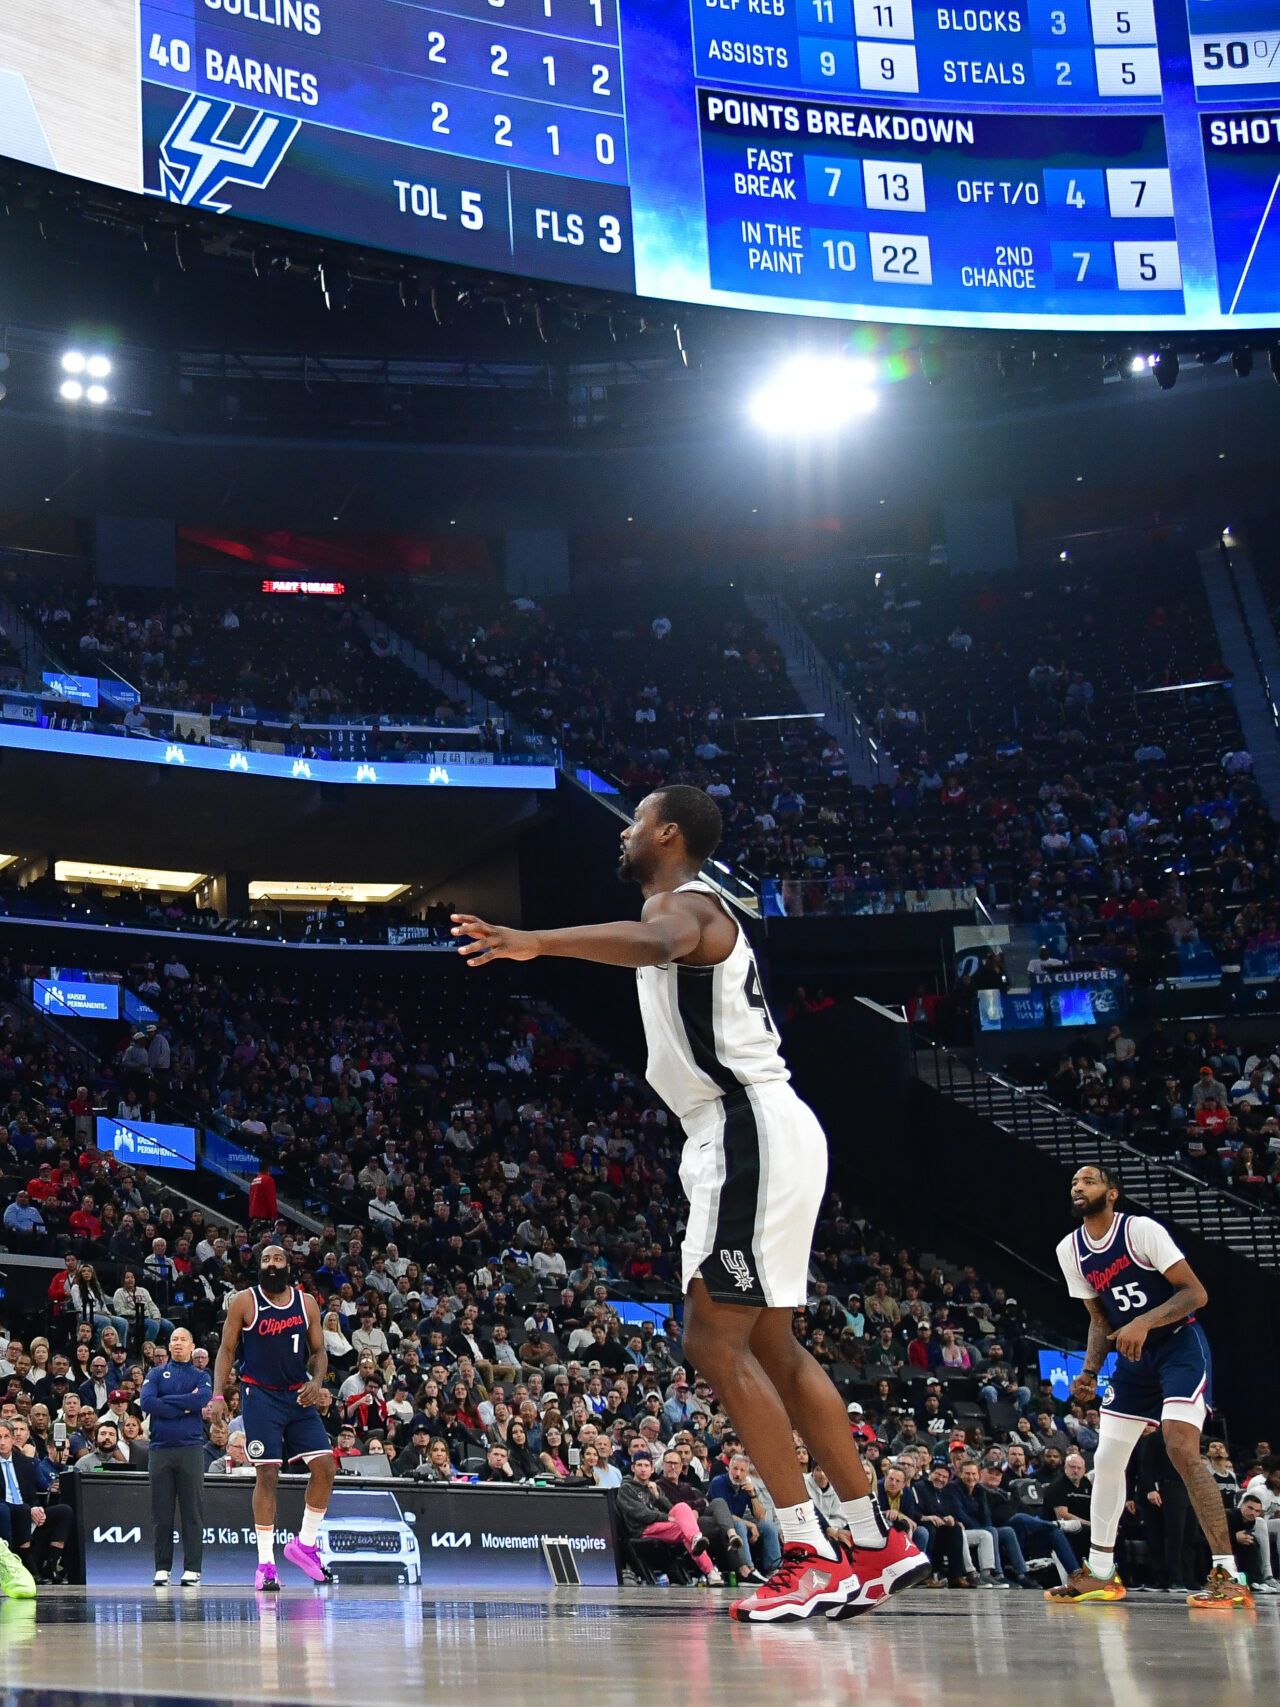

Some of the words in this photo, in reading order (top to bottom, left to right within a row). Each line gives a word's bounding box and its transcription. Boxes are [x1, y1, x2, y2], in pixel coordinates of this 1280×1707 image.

[590, 0, 602, 26] 1
[812, 0, 834, 24] 11
[873, 6, 893, 28] 11
[937, 8, 1021, 33] BLOCKS
[1050, 10, 1067, 36] 3
[1116, 11, 1131, 34] 5
[149, 33, 191, 73] 40
[205, 48, 319, 106] BARNES
[428, 31, 447, 64] 2
[490, 45, 509, 77] 2
[543, 56, 555, 86] 1
[592, 64, 610, 96] 2
[708, 39, 788, 69] ASSISTS
[820, 51, 836, 77] 9
[880, 58, 895, 80] 9
[943, 60, 1026, 85] STEALS
[1055, 61, 1072, 86] 2
[1121, 62, 1136, 85] 5
[431, 101, 450, 134] 2
[494, 114, 513, 147] 2
[546, 125, 560, 156] 1
[595, 133, 615, 165] 0
[707, 96, 800, 132] POINTS
[806, 109, 975, 145] BREAKDOWN
[734, 172, 796, 200] BREAK
[747, 147, 794, 174] FAST
[824, 167, 842, 197] 7
[877, 173, 910, 202] 13
[393, 179, 447, 221] TOL
[460, 190, 484, 231] 5
[956, 180, 995, 203] OFF
[999, 181, 1039, 205] T/O
[1066, 179, 1086, 209] 4
[1130, 180, 1147, 208] 7
[535, 208, 585, 246] FLS
[599, 214, 622, 254] 3
[741, 220, 762, 245] IN
[765, 223, 803, 249] THE
[822, 239, 857, 272] 10
[881, 244, 920, 275] 22
[748, 248, 804, 275] PAINT
[961, 267, 1036, 289] CHANCE
[995, 246, 1033, 267] 2ND
[1072, 252, 1091, 282] 7
[1139, 253, 1157, 281] 5
[1036, 973, 1052, 984] LA
[1055, 970, 1118, 984] CLIPPERS
[1111, 1282, 1148, 1312] 55
[259, 1315, 304, 1335] Clippers
[291, 1334, 300, 1353] 1
[1028, 1484, 1038, 1500] G
[93, 1526, 141, 1544] KIA
[218, 1527, 239, 1544] Kia
[431, 1532, 471, 1548] KIA
[482, 1532, 539, 1549] Movement
